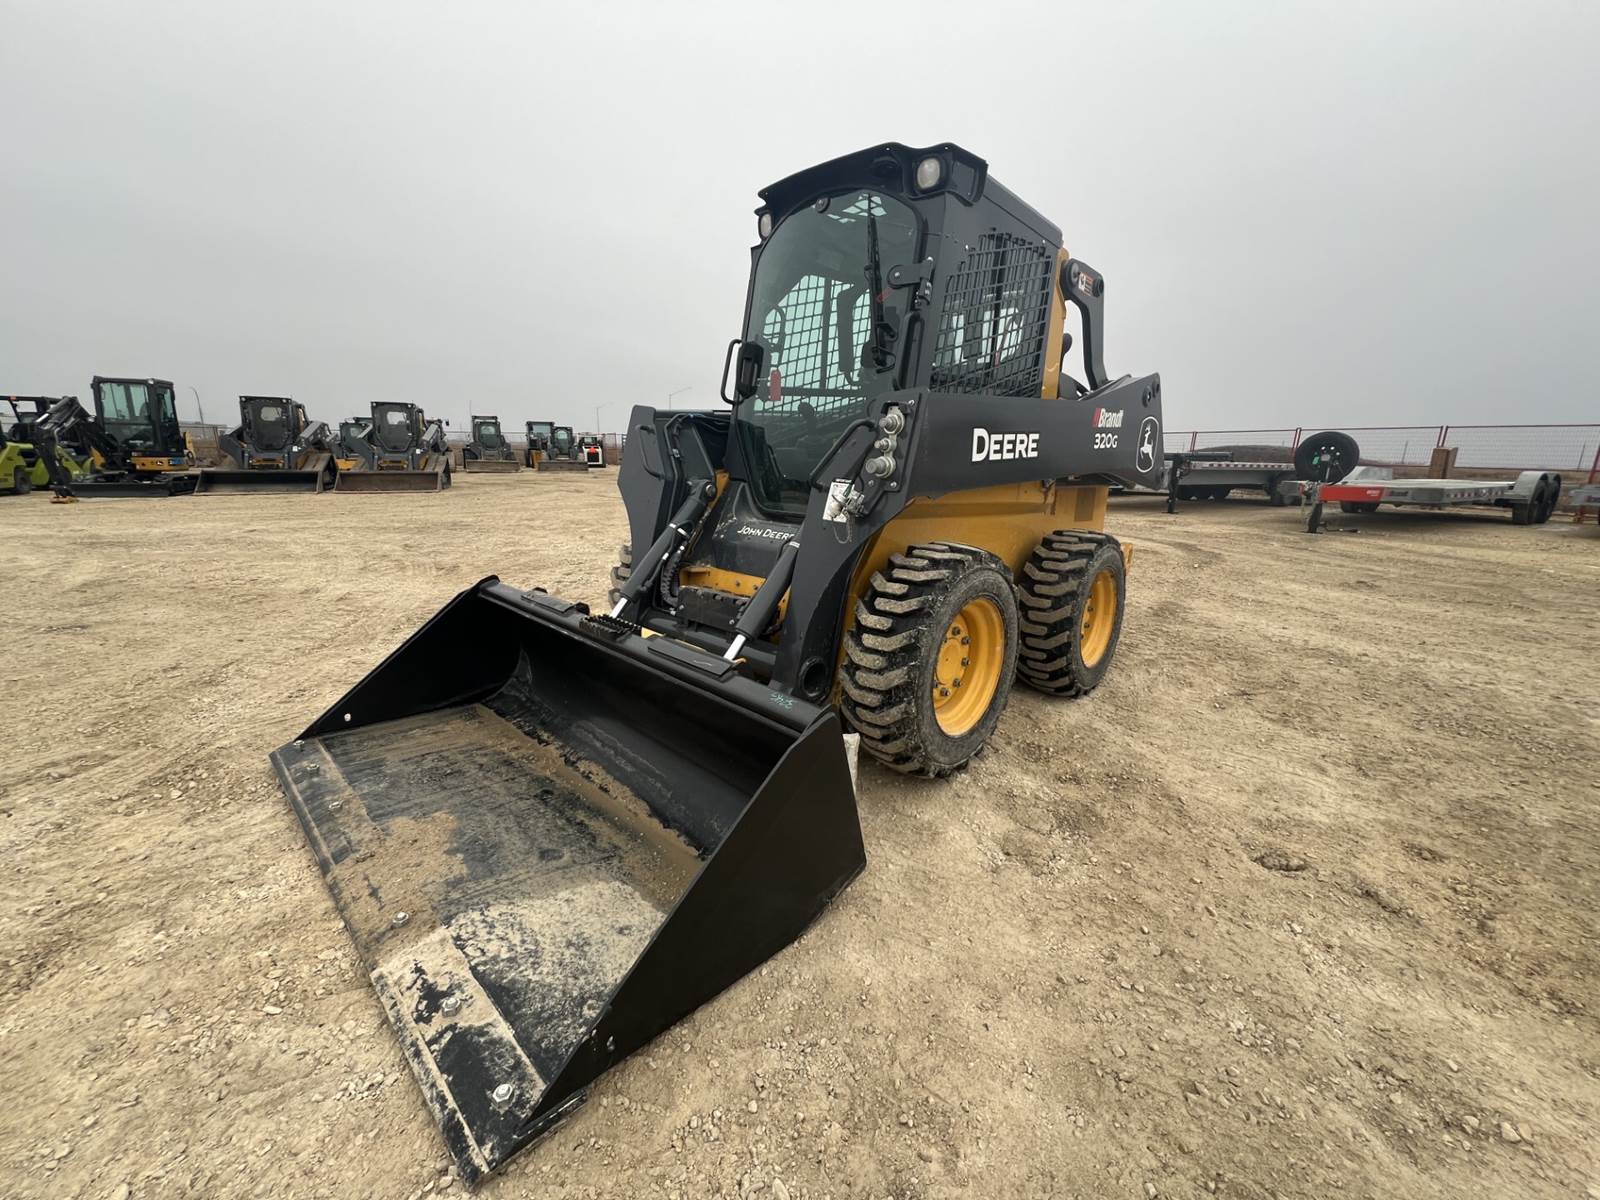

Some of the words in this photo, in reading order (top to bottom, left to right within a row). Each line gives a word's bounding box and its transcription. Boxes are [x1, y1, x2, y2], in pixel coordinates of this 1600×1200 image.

[971, 428, 1040, 462] DEERE
[1093, 433, 1118, 449] 320G
[737, 525, 762, 536] JOHN
